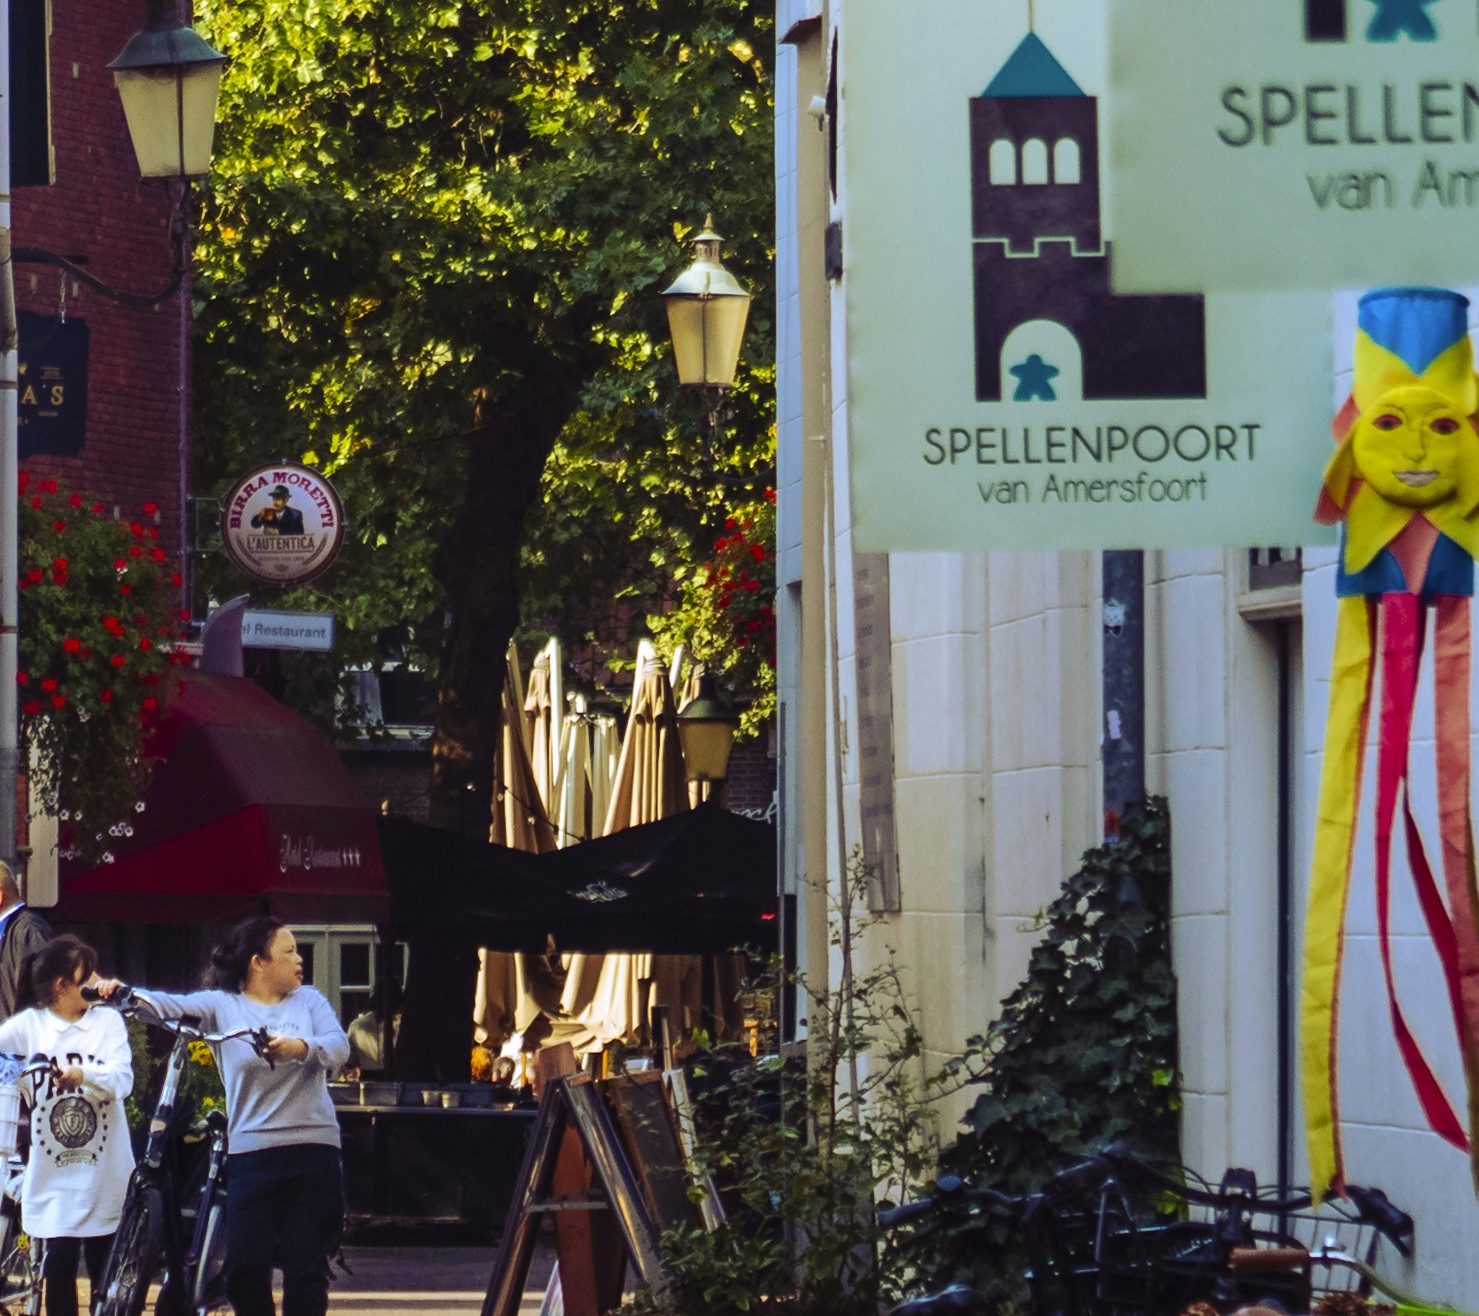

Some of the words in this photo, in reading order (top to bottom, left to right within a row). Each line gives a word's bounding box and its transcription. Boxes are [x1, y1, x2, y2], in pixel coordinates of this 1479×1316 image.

[1305, 165, 1398, 211] van
[922, 423, 1262, 468] SPELLENPOORT
[229, 476, 269, 529] BIRRA
[272, 471, 335, 529] MORETTI
[977, 478, 1034, 505] van
[1041, 471, 1208, 504] Amersfoort
[246, 536, 315, 551] L'AUTENTICA
[254, 623, 326, 639] Restaurant
